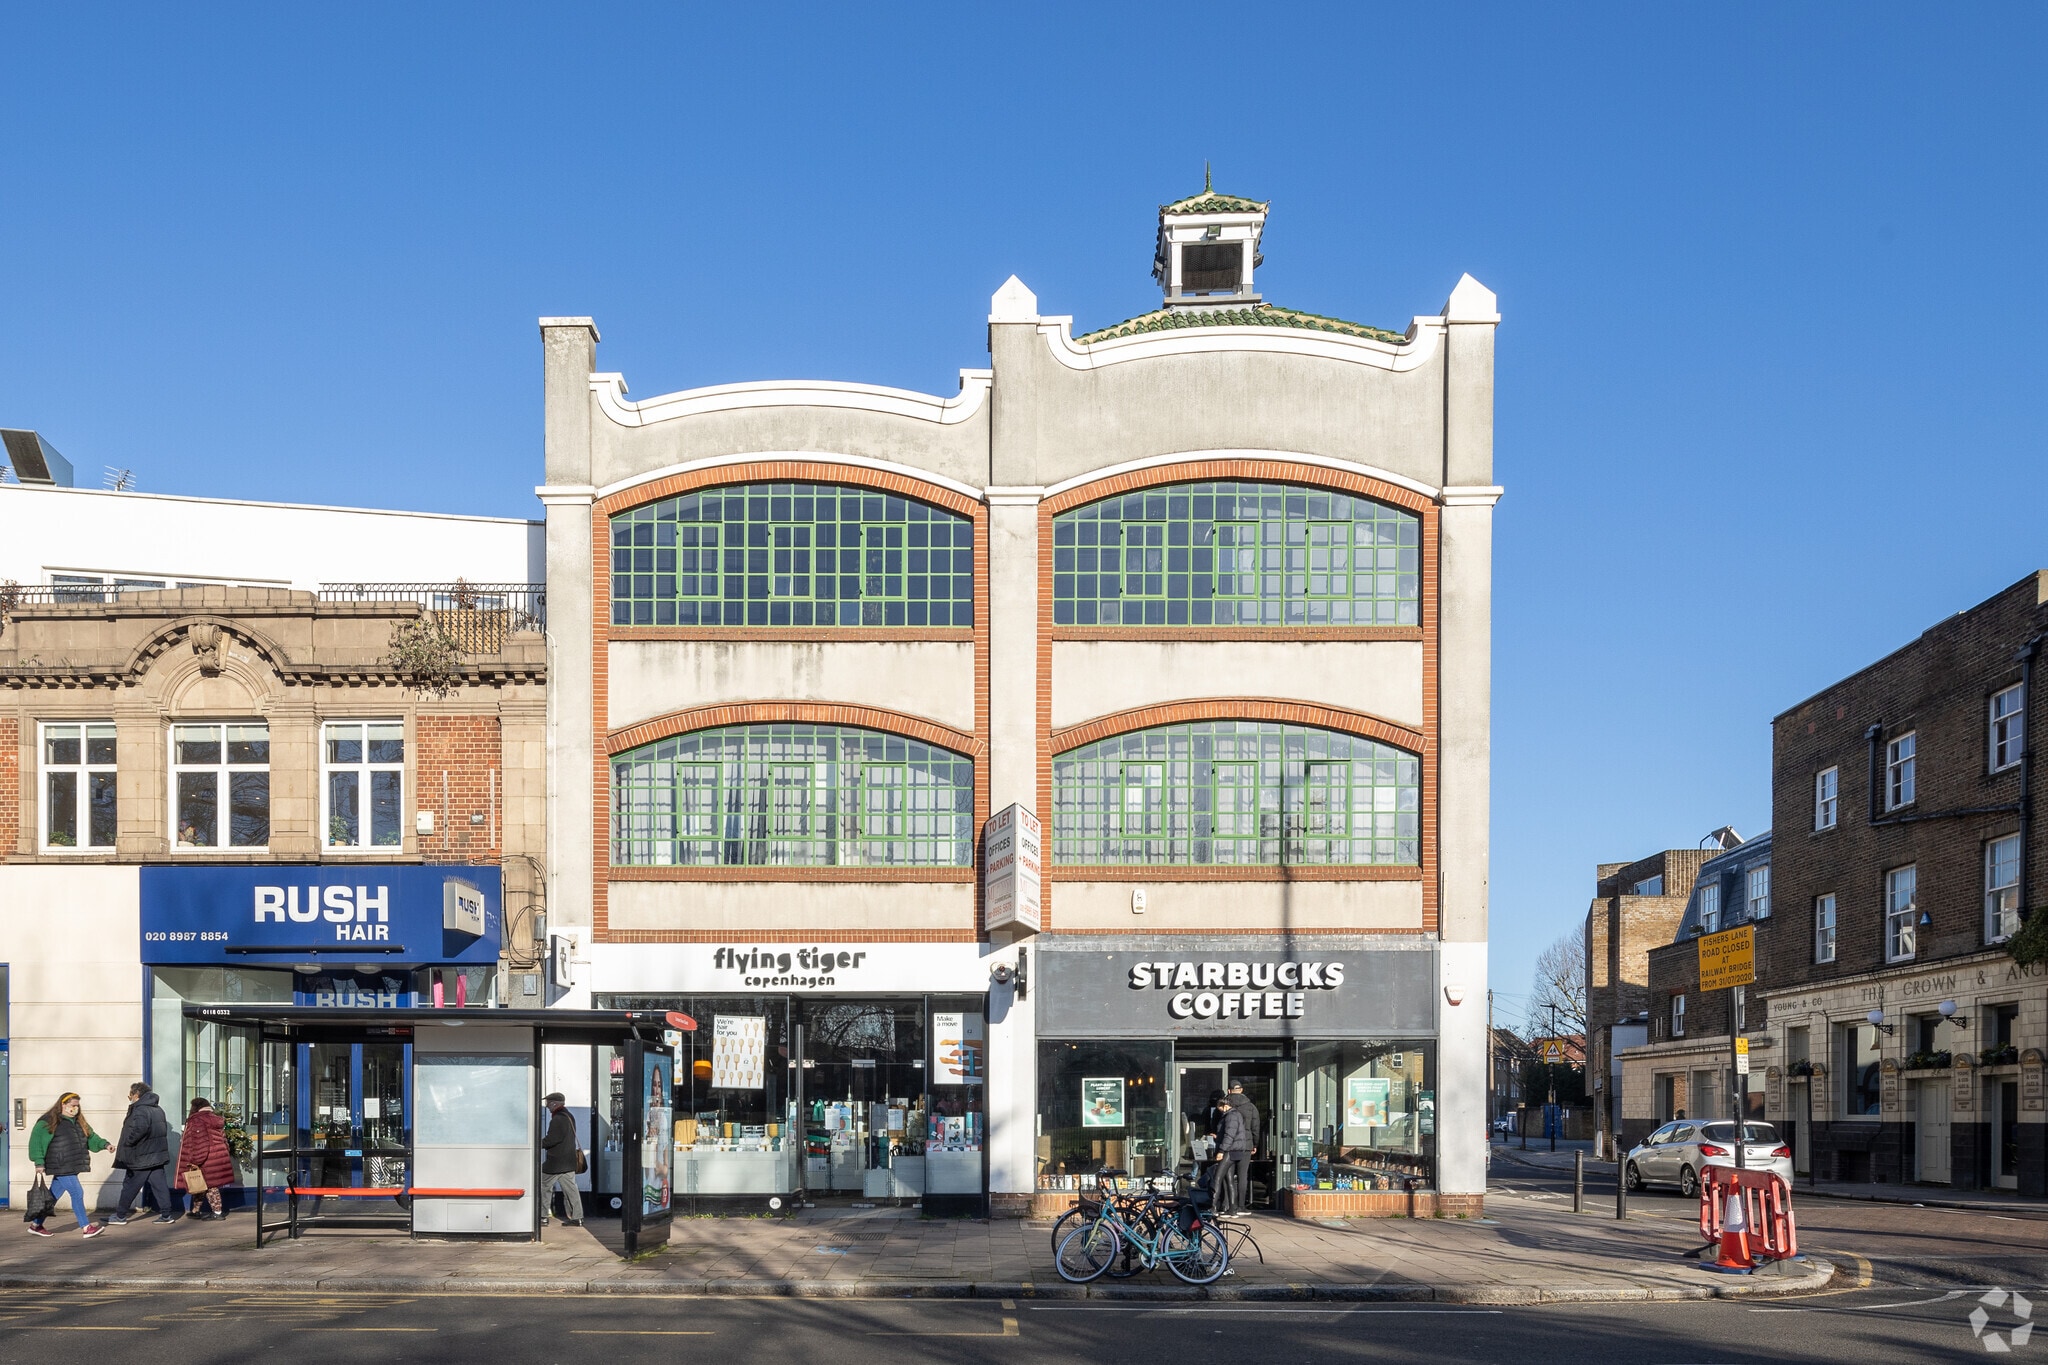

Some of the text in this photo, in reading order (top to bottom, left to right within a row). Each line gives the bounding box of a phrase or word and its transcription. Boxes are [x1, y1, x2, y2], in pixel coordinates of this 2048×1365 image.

[988, 811, 1011, 834] TO LET
[1021, 812, 1038, 833] TO LET
[988, 836, 1010, 857] OFFICES
[1022, 837, 1038, 857] OFFICES
[989, 852, 1014, 874] PARKING
[1023, 856, 1040, 876] PARKING
[254, 885, 389, 923] RUSH
[145, 932, 229, 941] 020 8987 8854
[336, 925, 389, 941] HAIR
[1703, 929, 1748, 947] FISHERS LANE
[1702, 940, 1750, 958] ROAD CLOSED
[713, 947, 866, 974] flying tiger
[1701, 961, 1752, 978] RAILWAY BRIDGE
[1722, 955, 1730, 965] AT
[744, 974, 835, 988] copenhagen
[1130, 961, 1345, 988] STARBUCKS
[1702, 972, 1752, 989] FROM 31/07/2020
[1903, 975, 1956, 996] CROWN
[1977, 970, 1986, 985] &
[316, 988, 397, 1008] RUSH
[1170, 992, 1305, 1018] COFFEE
[1774, 998, 1822, 1012] YOUNG & CO
